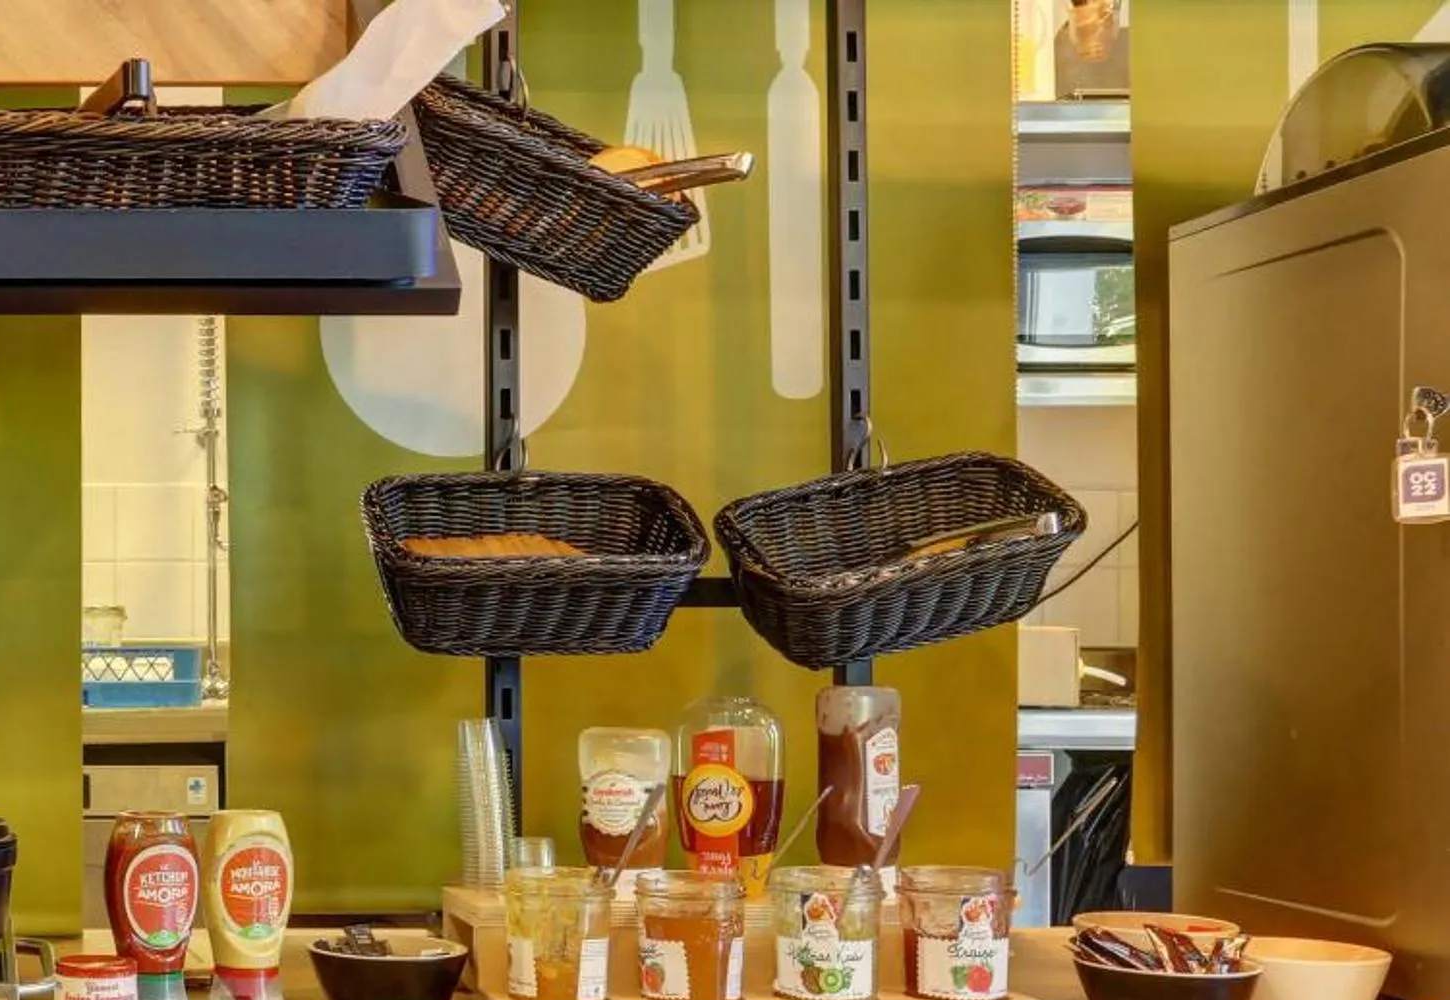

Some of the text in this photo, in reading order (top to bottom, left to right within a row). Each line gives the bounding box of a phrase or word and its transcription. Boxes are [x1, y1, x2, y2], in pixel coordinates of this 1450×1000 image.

[1409, 471, 1437, 485] OC
[1411, 484, 1437, 496] 22
[139, 871, 189, 888] KETCHUP
[230, 879, 282, 897] AMORA
[137, 886, 189, 905] AMORA
